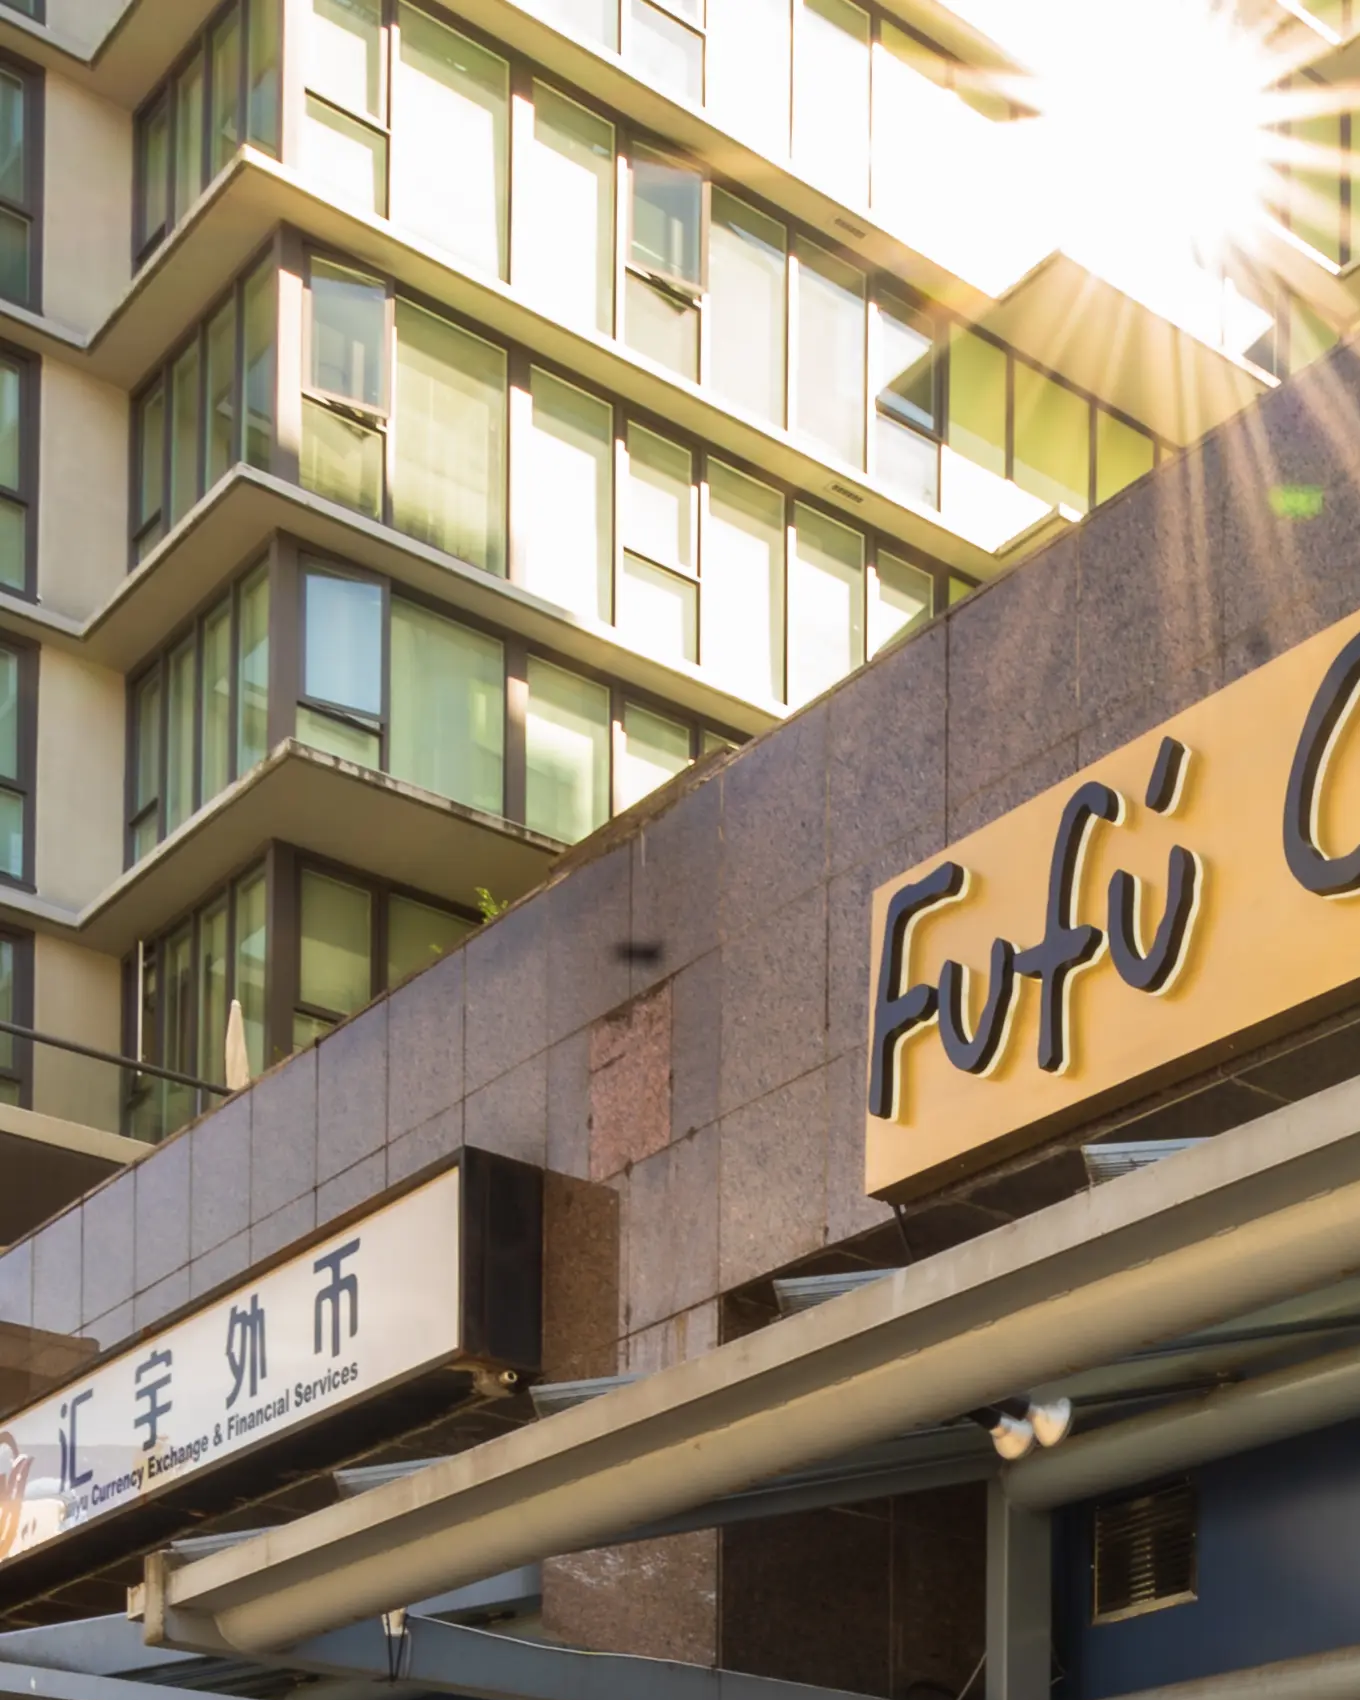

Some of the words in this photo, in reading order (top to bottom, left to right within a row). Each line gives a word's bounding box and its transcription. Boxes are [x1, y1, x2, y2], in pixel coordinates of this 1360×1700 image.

[869, 735, 1203, 1121] Fufú
[58, 1237, 361, 1493] 汇宇外币
[91, 1464, 145, 1505] Currency
[147, 1433, 209, 1479] Exchange
[212, 1423, 224, 1446] &
[227, 1388, 290, 1441] Financial
[294, 1361, 358, 1407] Services
